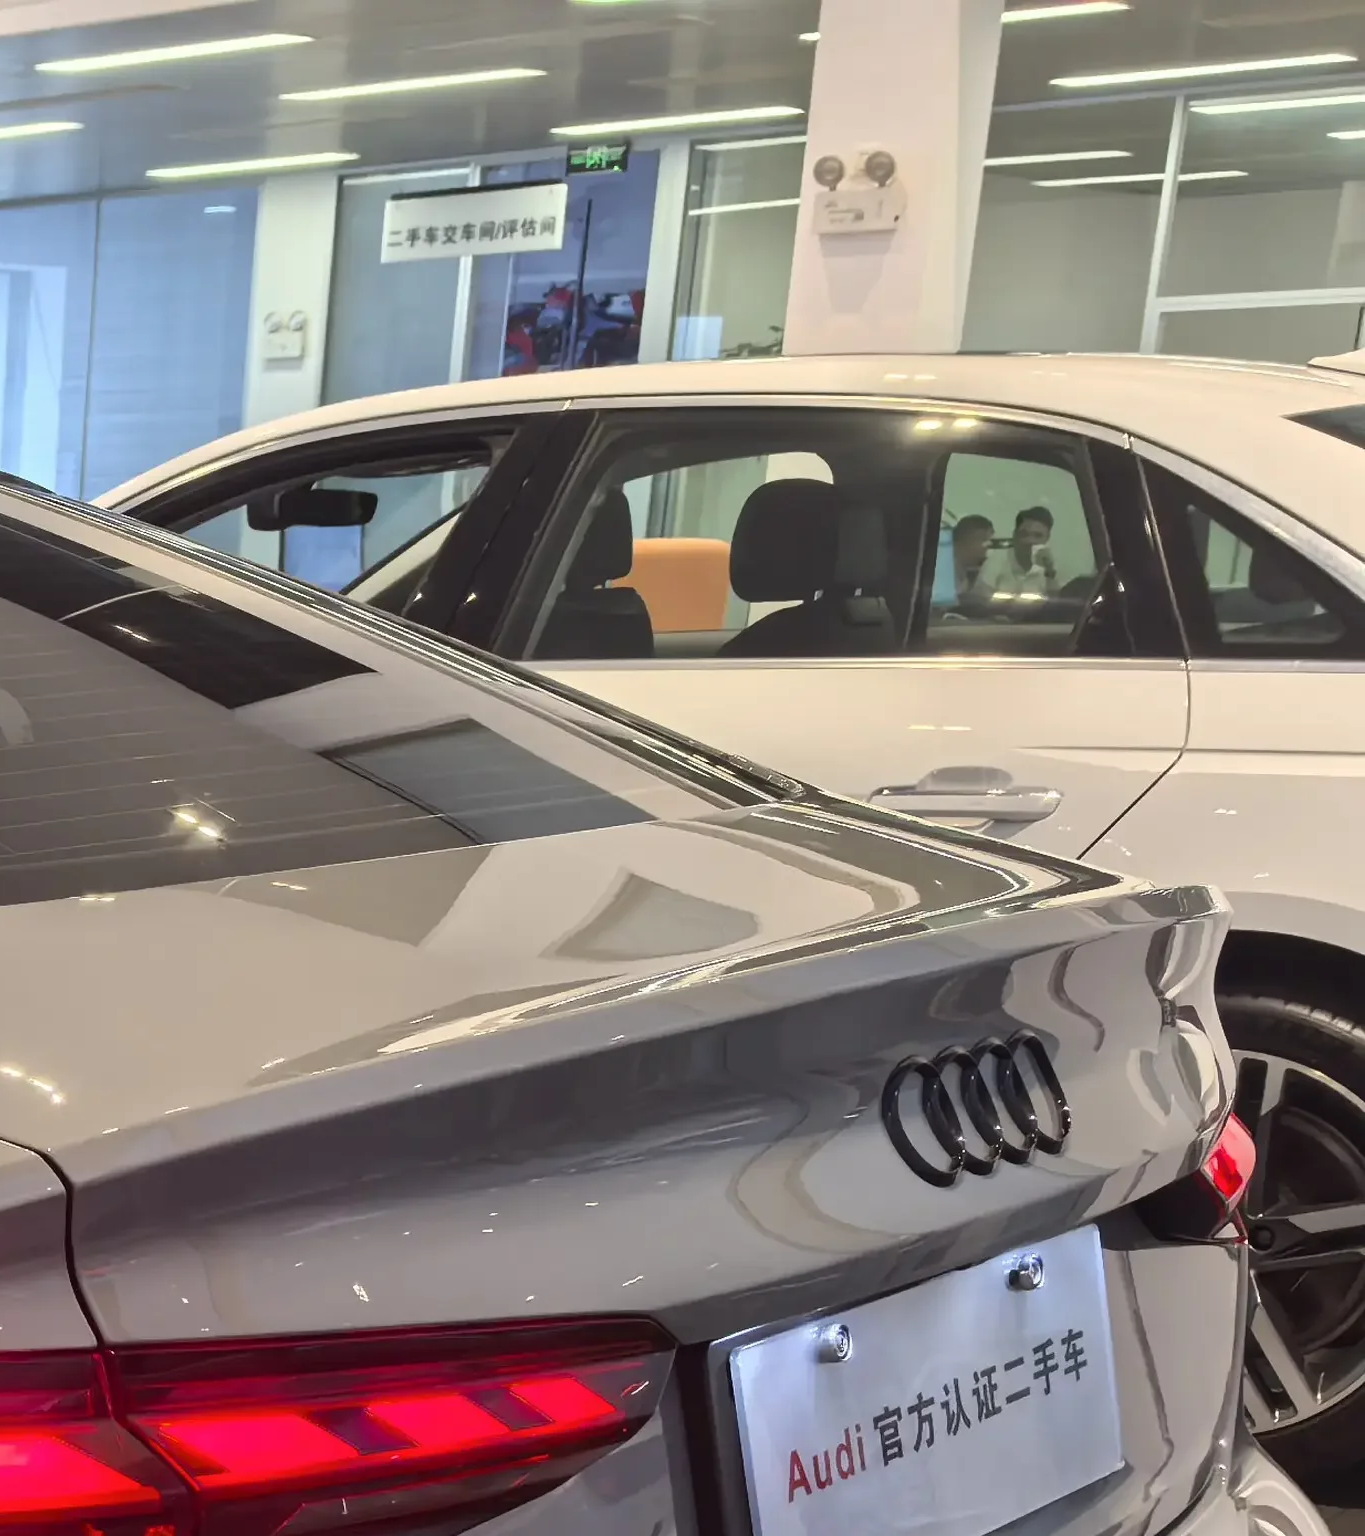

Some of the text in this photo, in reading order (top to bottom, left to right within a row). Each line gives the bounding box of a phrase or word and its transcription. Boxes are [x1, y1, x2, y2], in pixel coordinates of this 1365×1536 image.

[787, 1328, 1089, 1503] Audi 官方认证二手车
